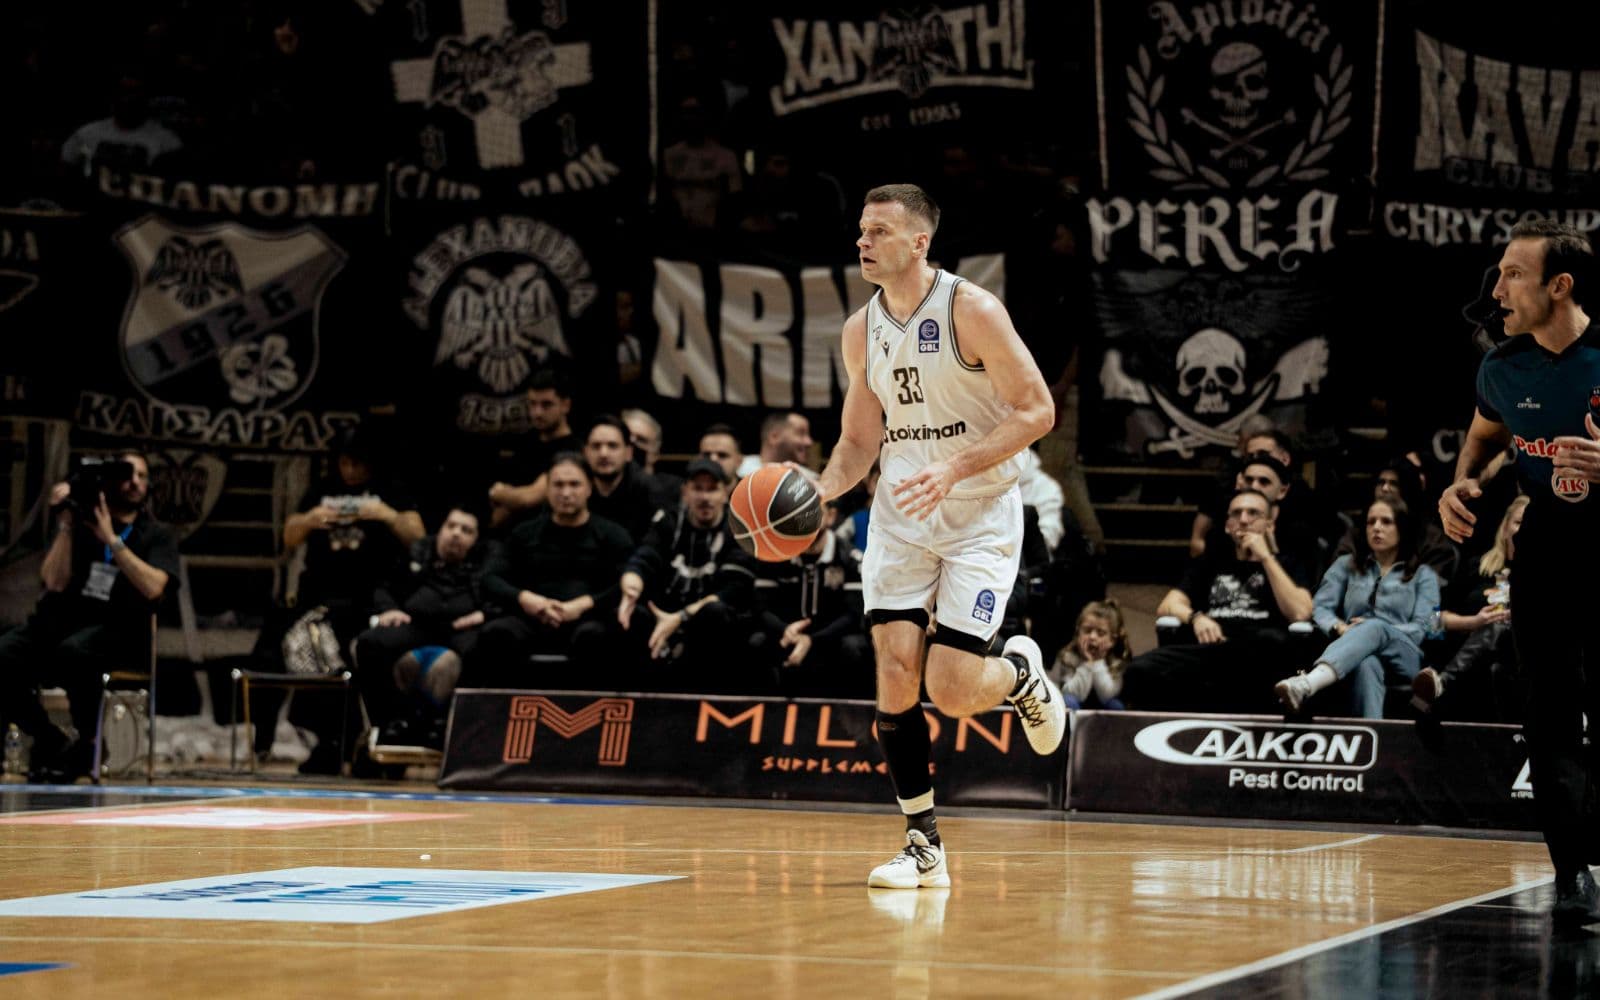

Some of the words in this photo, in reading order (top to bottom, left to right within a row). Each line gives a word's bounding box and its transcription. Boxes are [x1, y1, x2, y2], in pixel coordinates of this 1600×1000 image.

[1086, 188, 1340, 272] PEREA
[919, 342, 939, 353] GBL
[893, 366, 925, 406] 33
[760, 754, 938, 776] SUPPLEMES
[1228, 768, 1278, 789] Pest
[1282, 770, 1365, 793] Control
